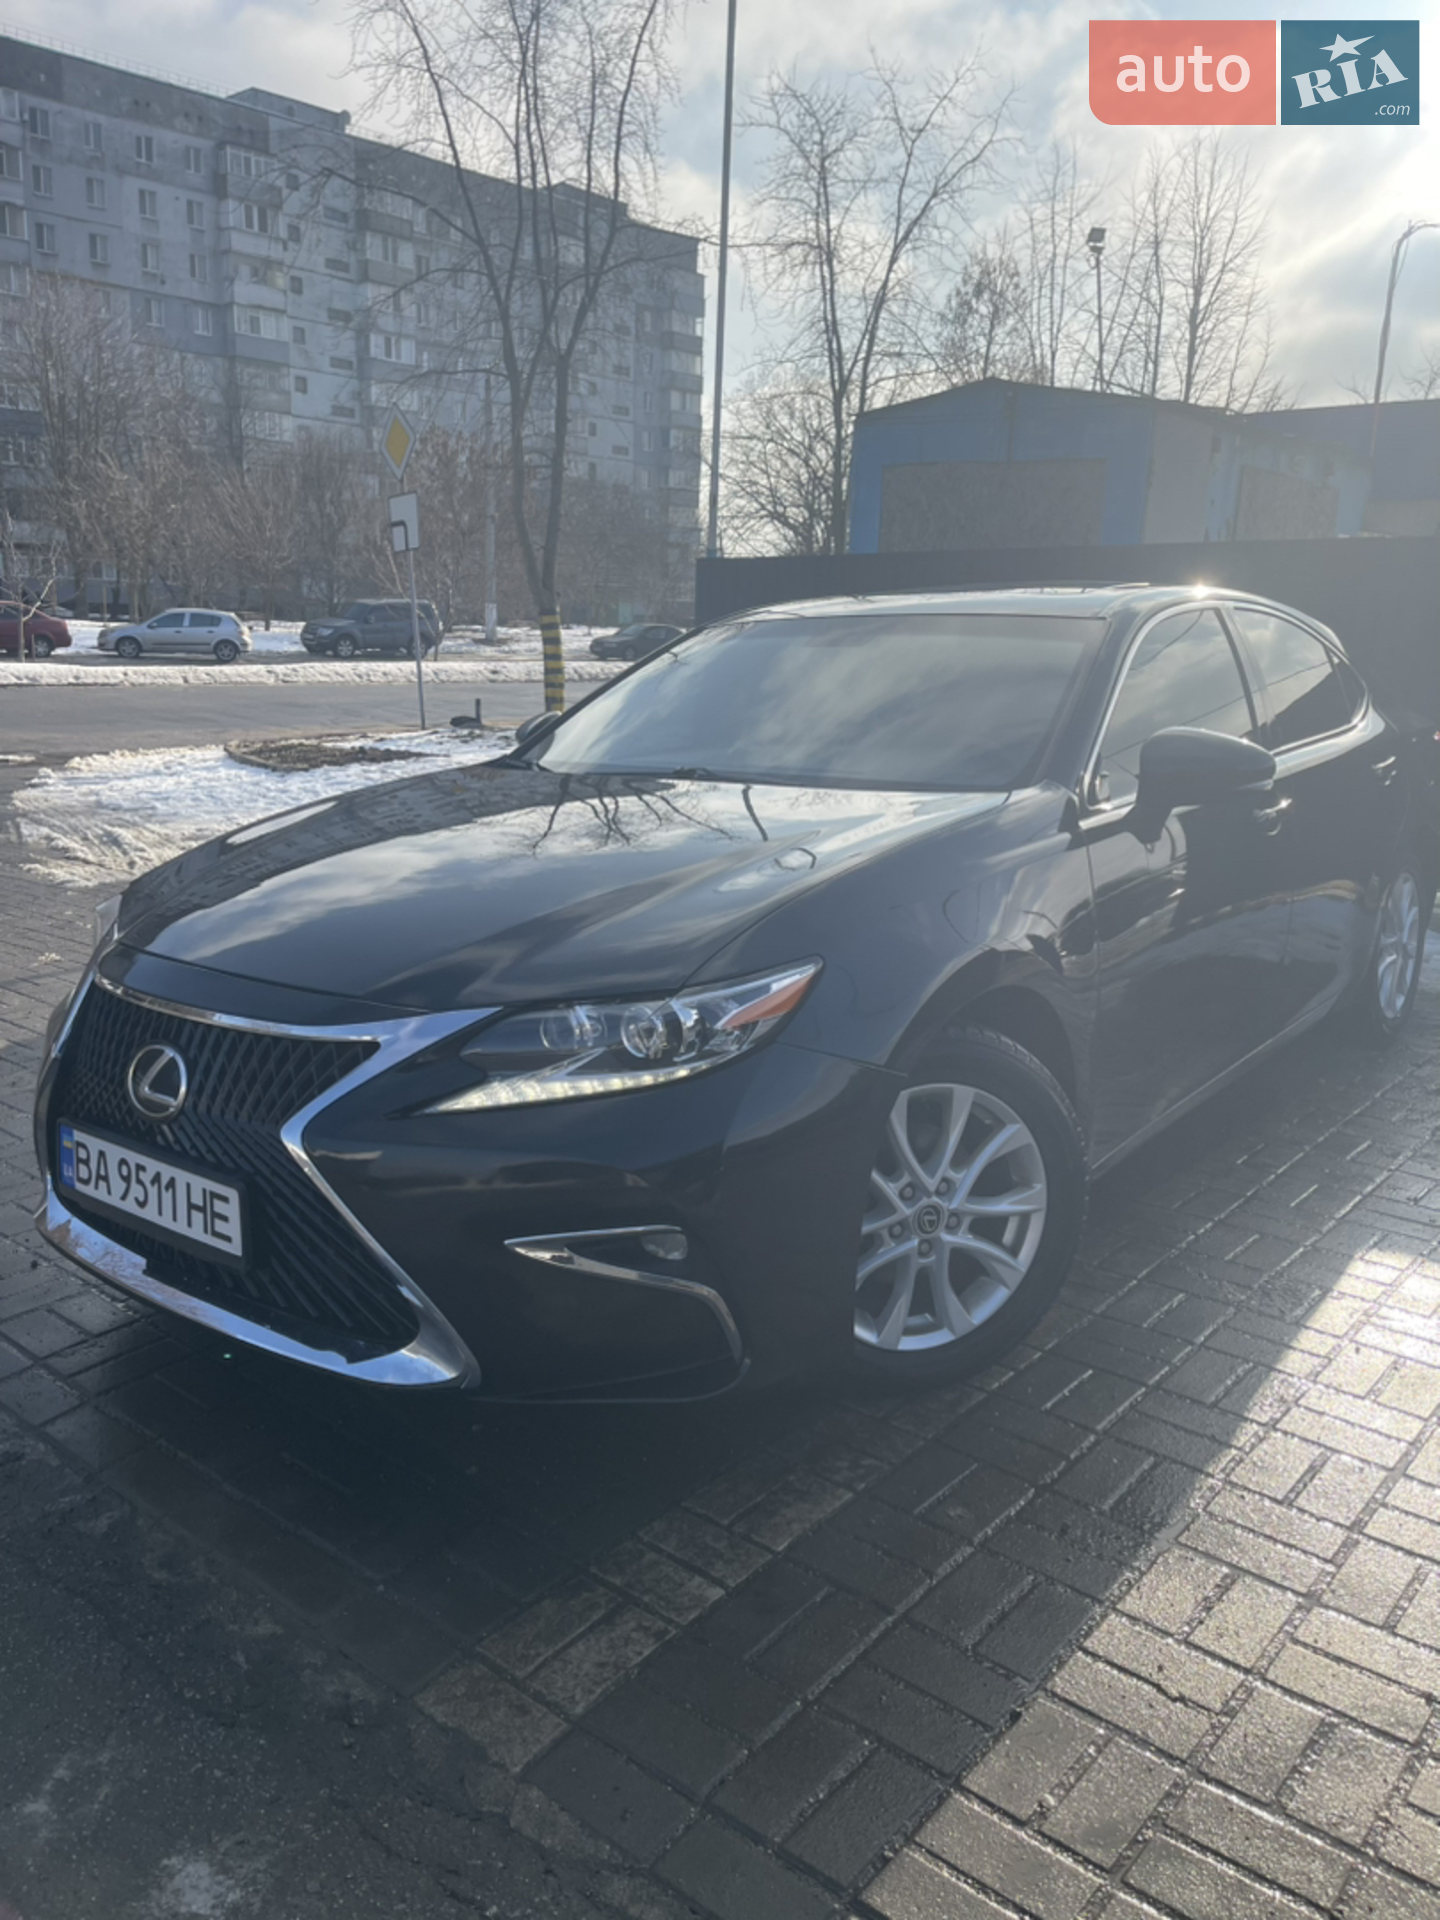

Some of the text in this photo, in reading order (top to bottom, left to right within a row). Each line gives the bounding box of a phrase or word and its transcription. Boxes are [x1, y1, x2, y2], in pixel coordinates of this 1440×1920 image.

[75, 1140, 232, 1243] BA 9511 HE
